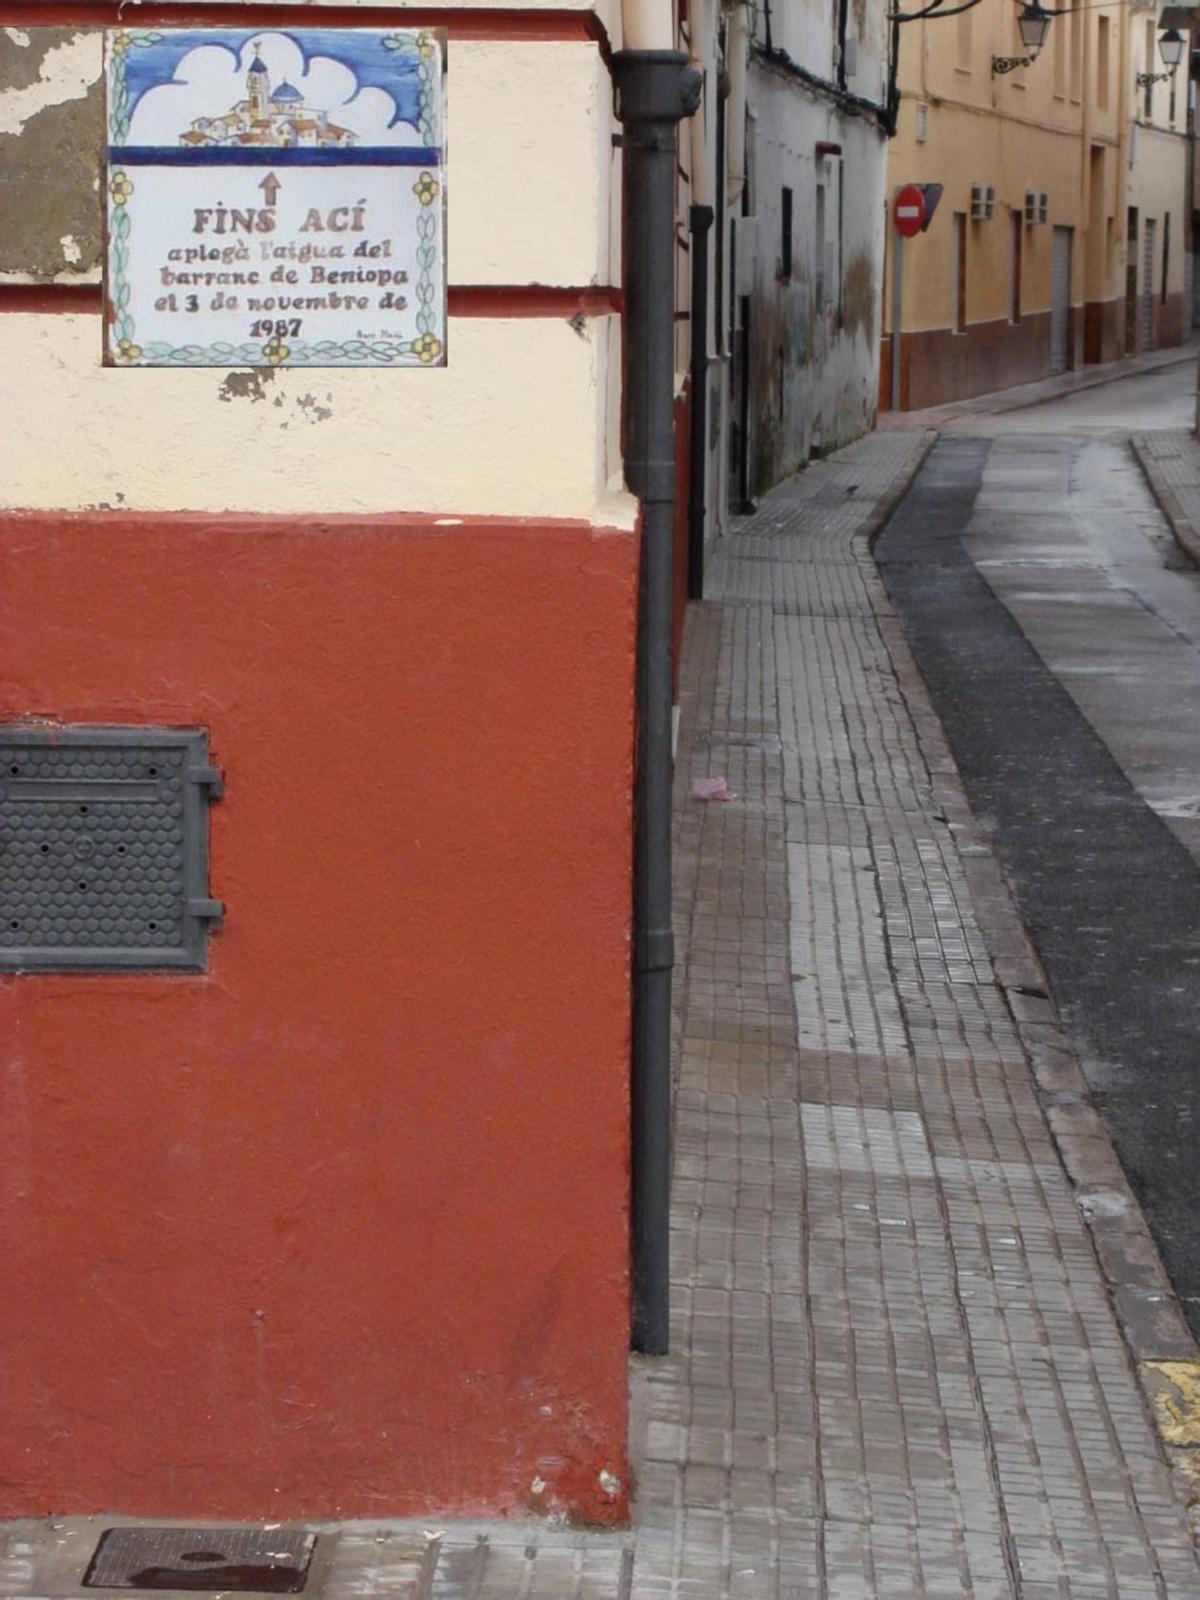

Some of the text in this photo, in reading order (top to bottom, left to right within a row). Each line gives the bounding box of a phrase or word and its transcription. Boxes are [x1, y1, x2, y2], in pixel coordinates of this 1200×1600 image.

[299, 198, 367, 232] ACÍ
[167, 238, 250, 264] aplegà
[353, 239, 392, 258] del
[160, 265, 408, 286] barranc de Beniopa
[154, 291, 408, 312] el 3 de novembre de
[249, 318, 303, 338] 1987
